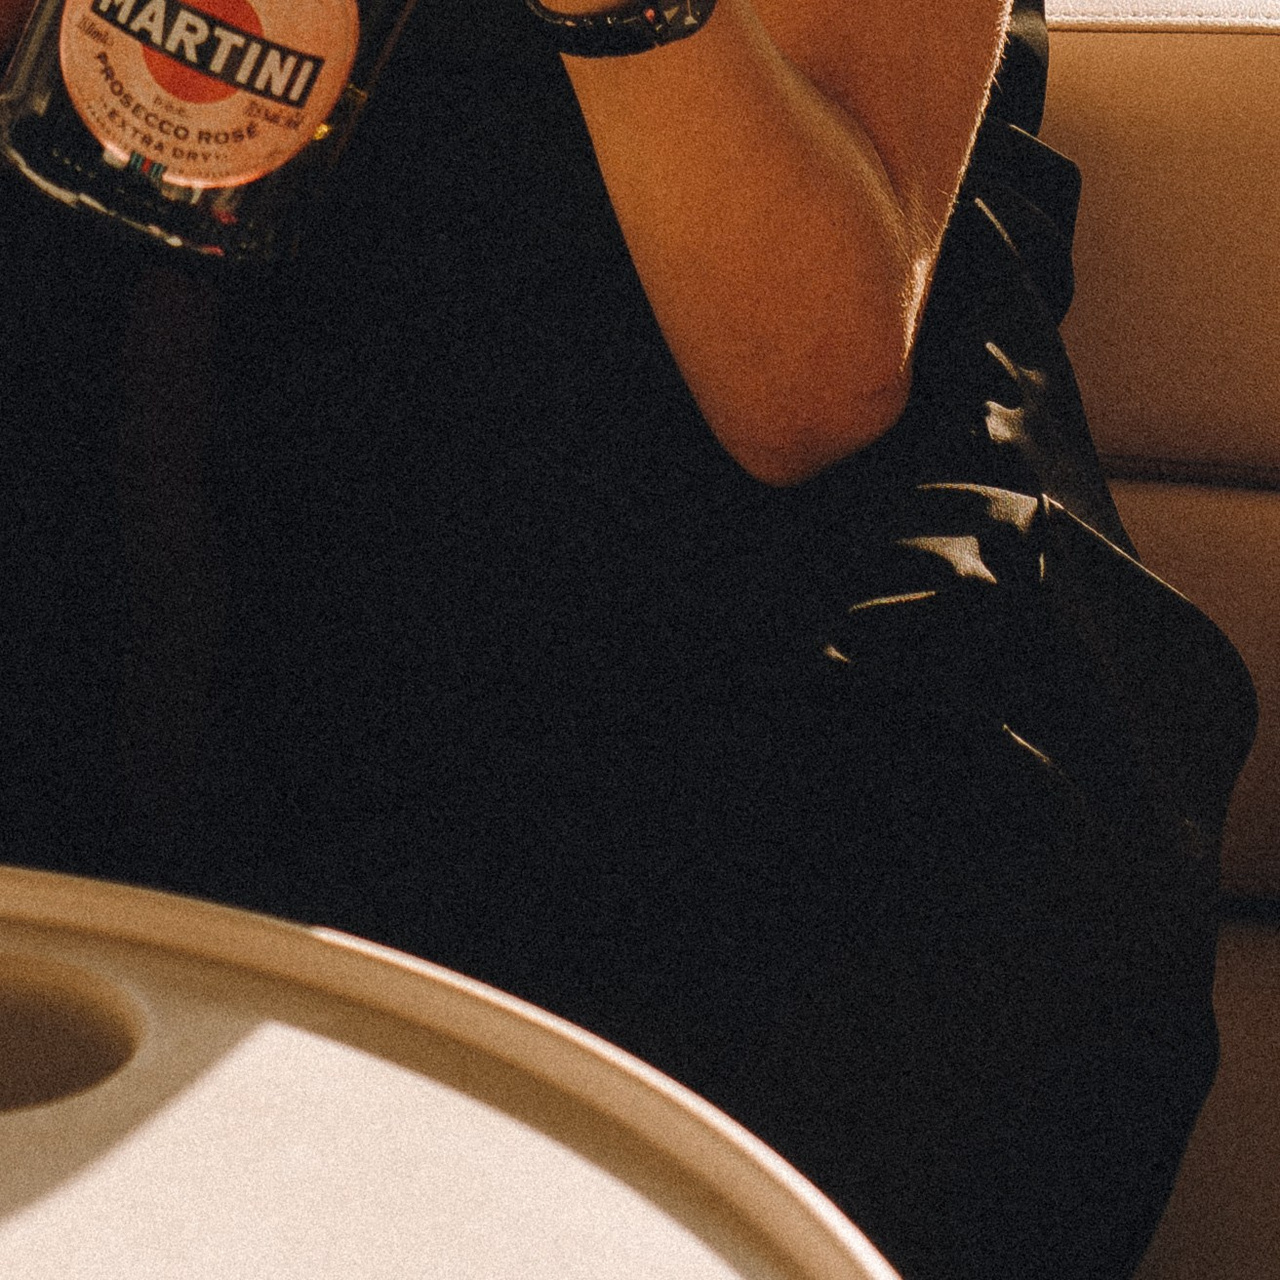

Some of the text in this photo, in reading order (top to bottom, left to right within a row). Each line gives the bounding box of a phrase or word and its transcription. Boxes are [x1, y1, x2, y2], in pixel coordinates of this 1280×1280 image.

[94, 51, 189, 141] PROSECCO
[108, 108, 164, 152] EXTRA
[172, 147, 211, 162] DRY
